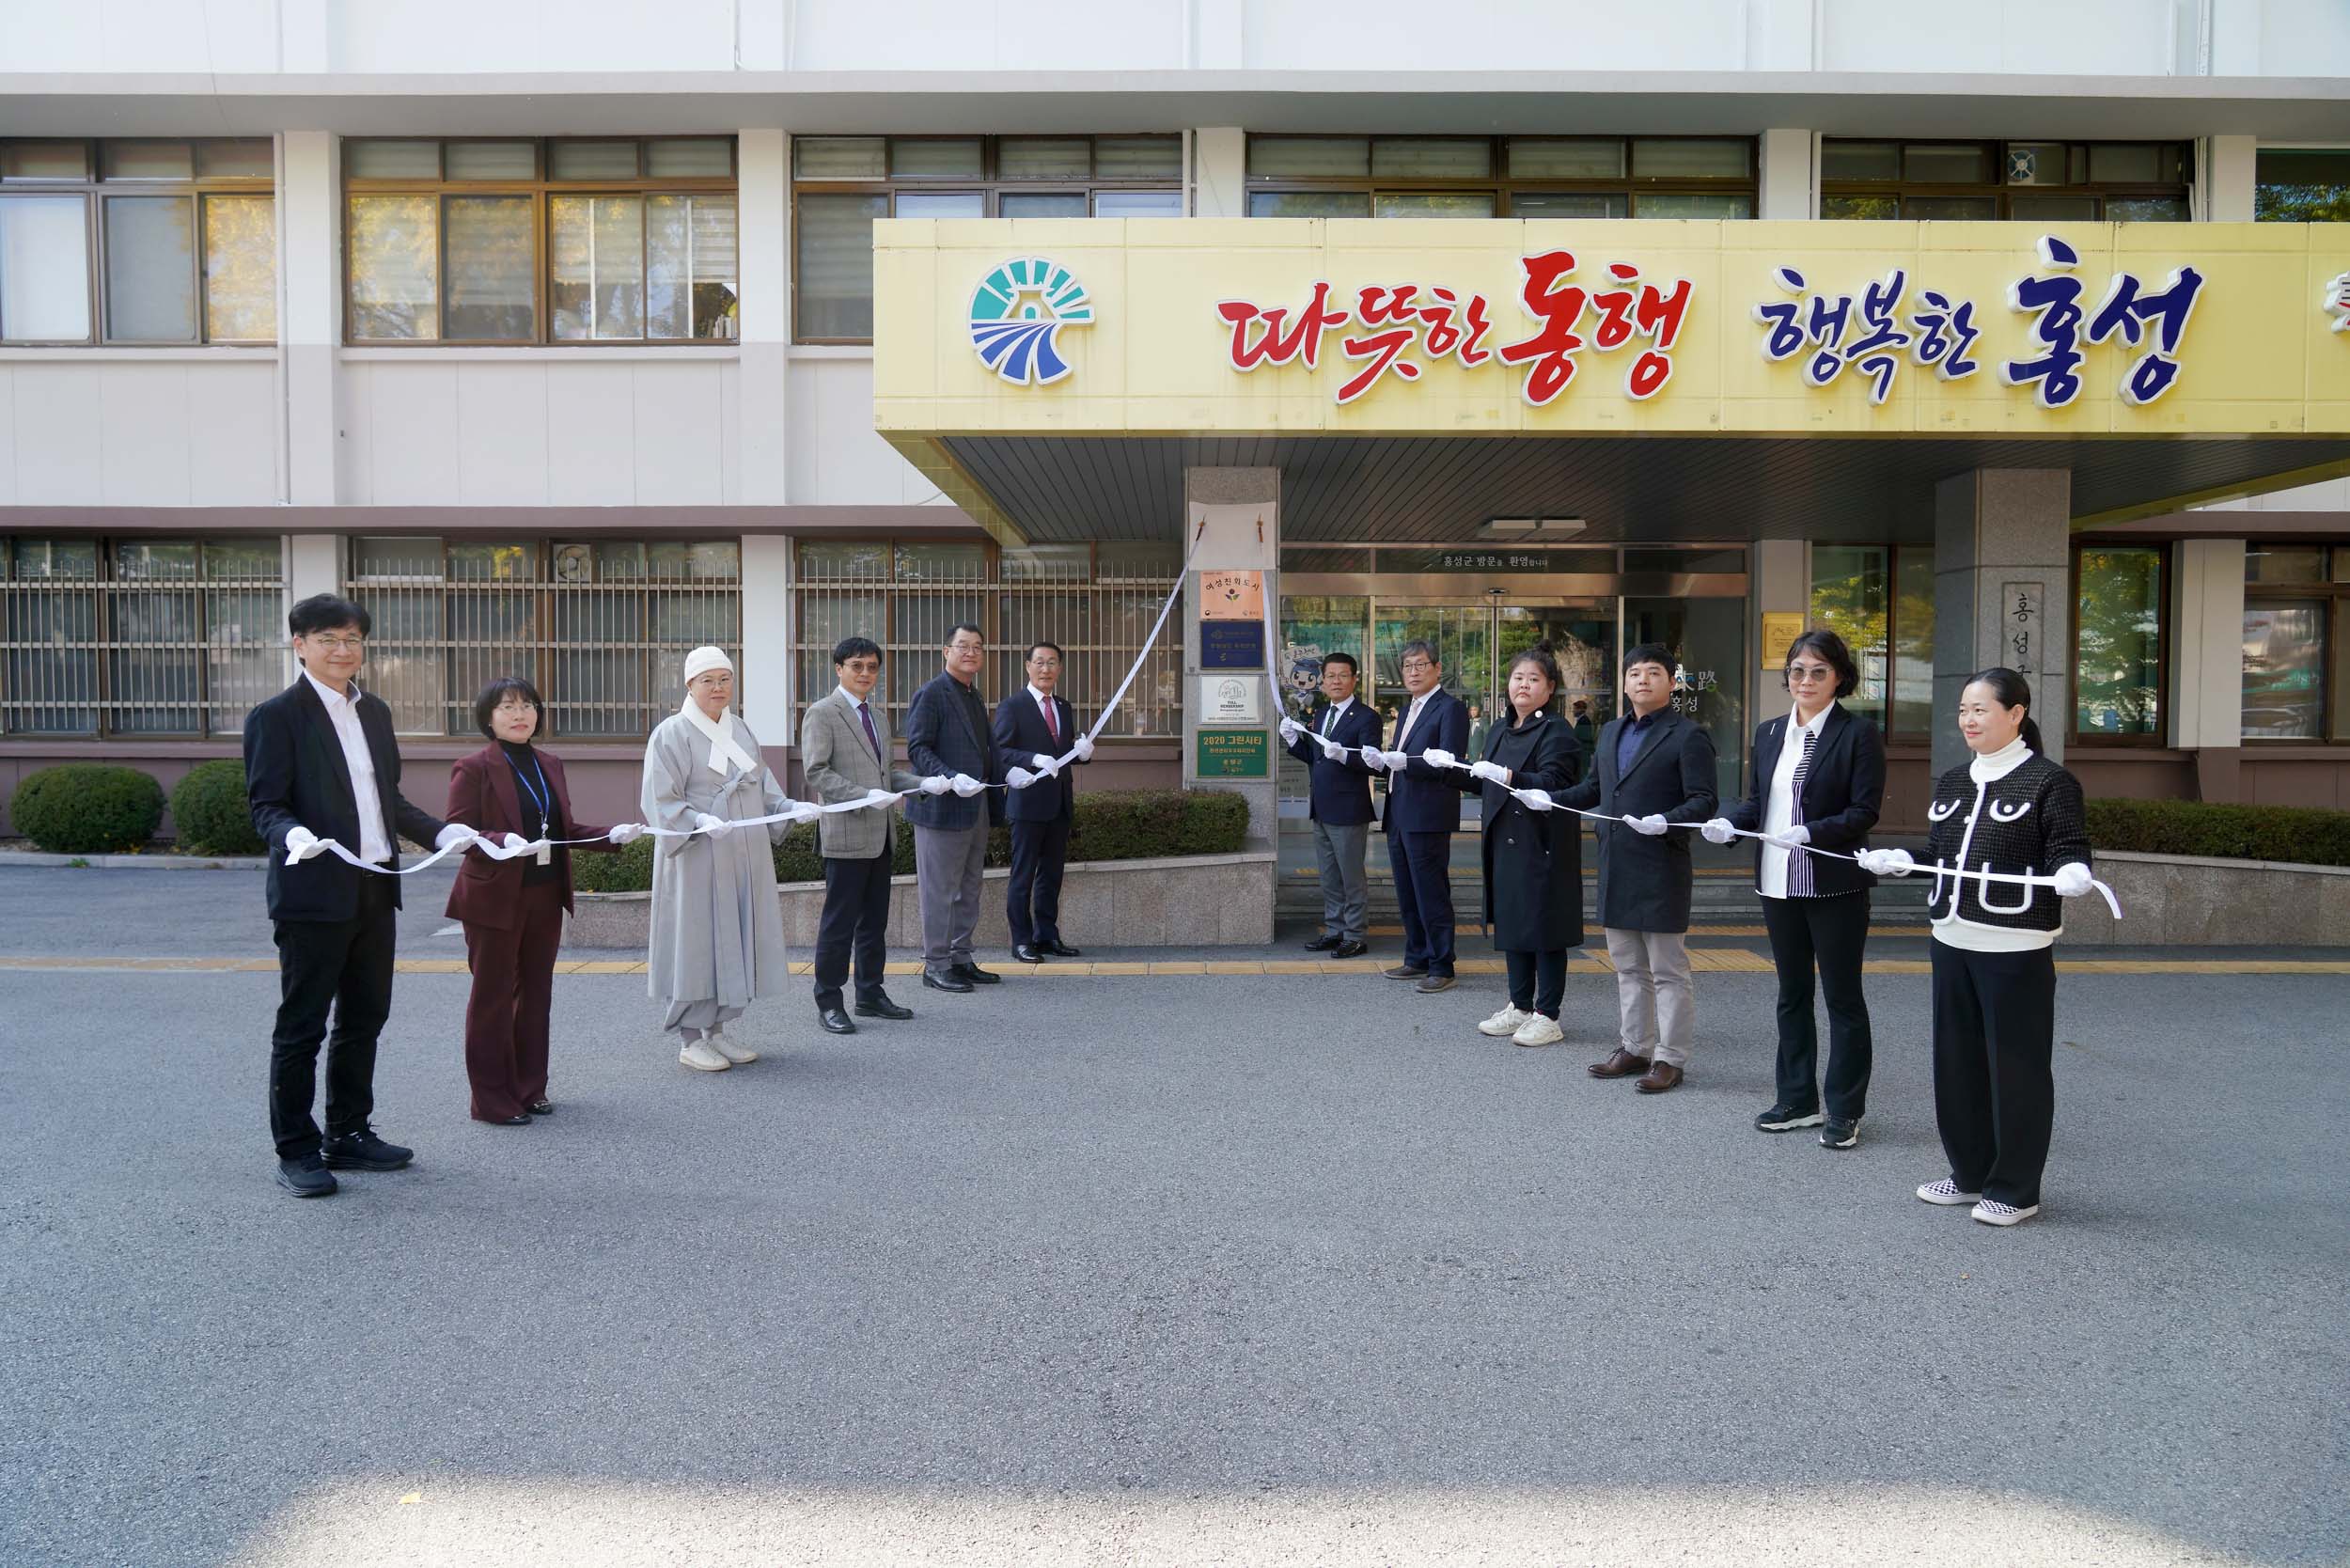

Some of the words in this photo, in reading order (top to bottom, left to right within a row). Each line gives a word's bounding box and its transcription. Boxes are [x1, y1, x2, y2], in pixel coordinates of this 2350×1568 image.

[1217, 280, 1493, 405] 따뜻한
[1497, 249, 1694, 406] 동행
[1754, 265, 1980, 405] 행복한
[2000, 234, 2205, 408] 홍성
[1444, 556, 1473, 567] 홍성군
[1205, 577, 1261, 591] 여성친화도시
[1671, 696, 1698, 712] 홍성
[1203, 736, 1226, 745] 2020
[1228, 736, 1262, 745] 그린시티
